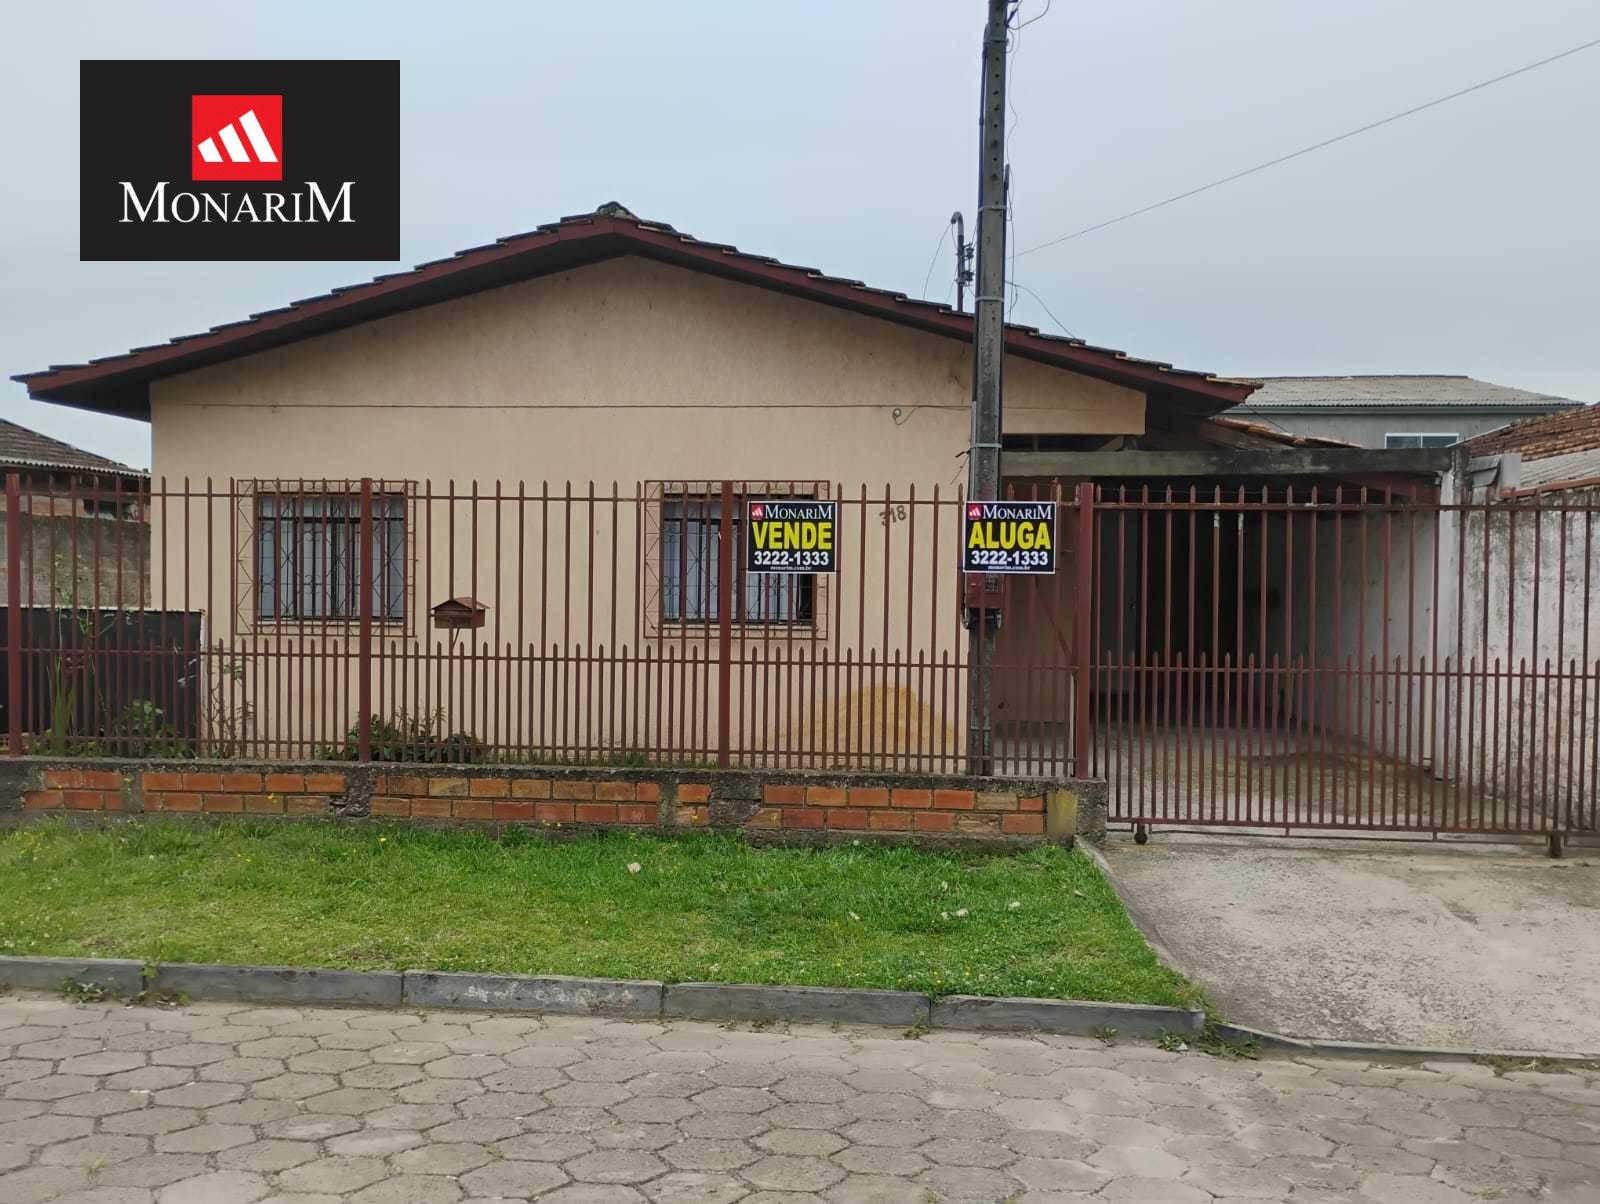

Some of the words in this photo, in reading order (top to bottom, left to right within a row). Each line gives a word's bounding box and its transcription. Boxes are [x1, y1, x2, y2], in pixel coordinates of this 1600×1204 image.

[765, 504, 832, 519] MONARIM
[982, 504, 1052, 520] MONARIM
[752, 521, 832, 549] VENDE
[967, 521, 1051, 549] ALUGA
[754, 550, 829, 565] 3222-1333
[971, 550, 1048, 565] 3222-1333
